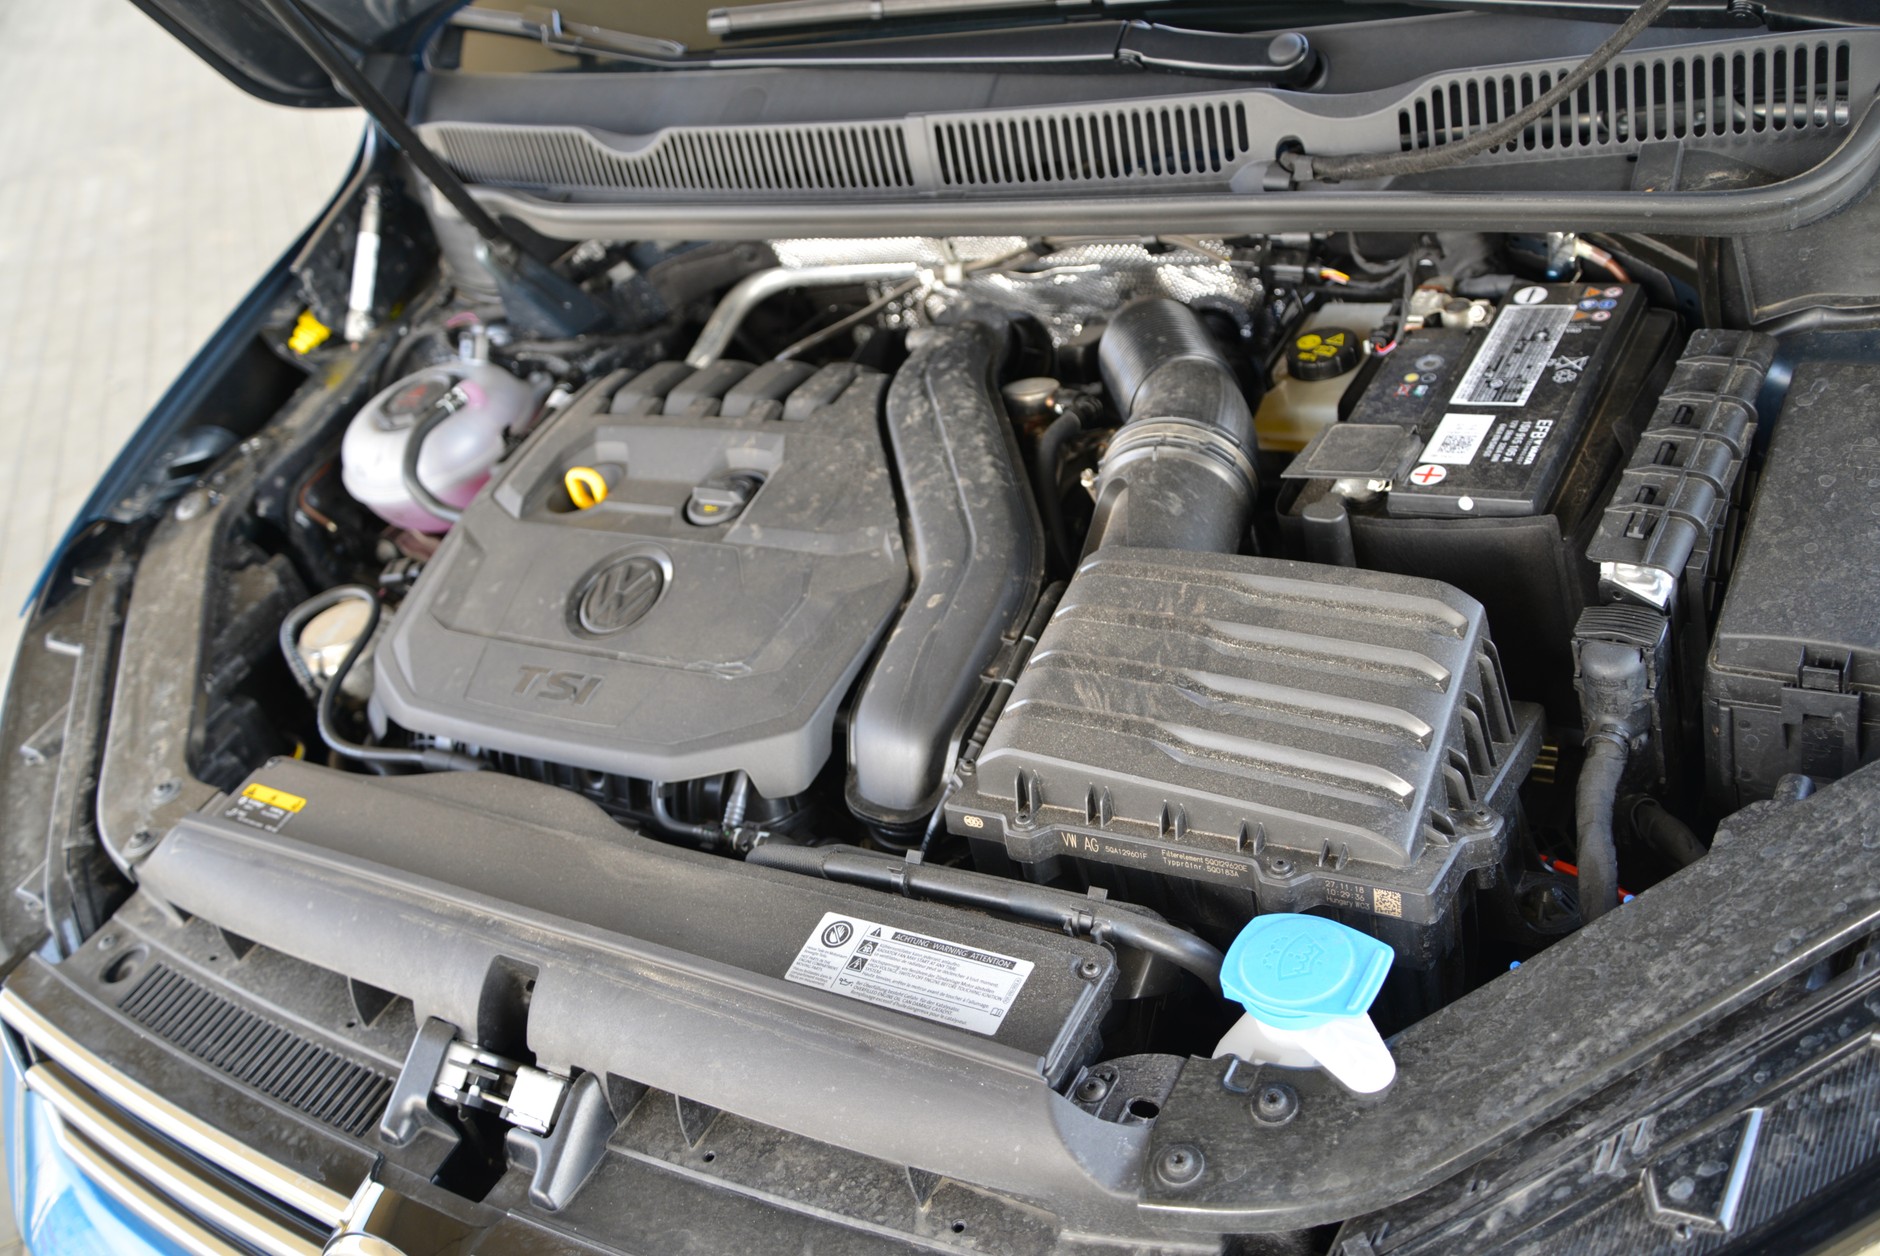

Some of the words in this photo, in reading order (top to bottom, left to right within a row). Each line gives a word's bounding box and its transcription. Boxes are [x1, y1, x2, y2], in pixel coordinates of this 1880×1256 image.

[1530, 420, 1553, 439] EFB
[512, 664, 603, 706] TSI
[1061, 832, 1077, 848] VW
[1084, 836, 1099, 853] AG
[1104, 845, 1148, 860] 5QA129601F
[1161, 849, 1204, 864] Filterelement
[1325, 880, 1364, 894] 27.11.18
[1326, 888, 1365, 902] 10:29:36
[1326, 896, 1354, 907] Hungary
[894, 933, 930, 946] ACHTUNG
[931, 942, 968, 956] WARNING
[969, 952, 1011, 967] ATTENTION
